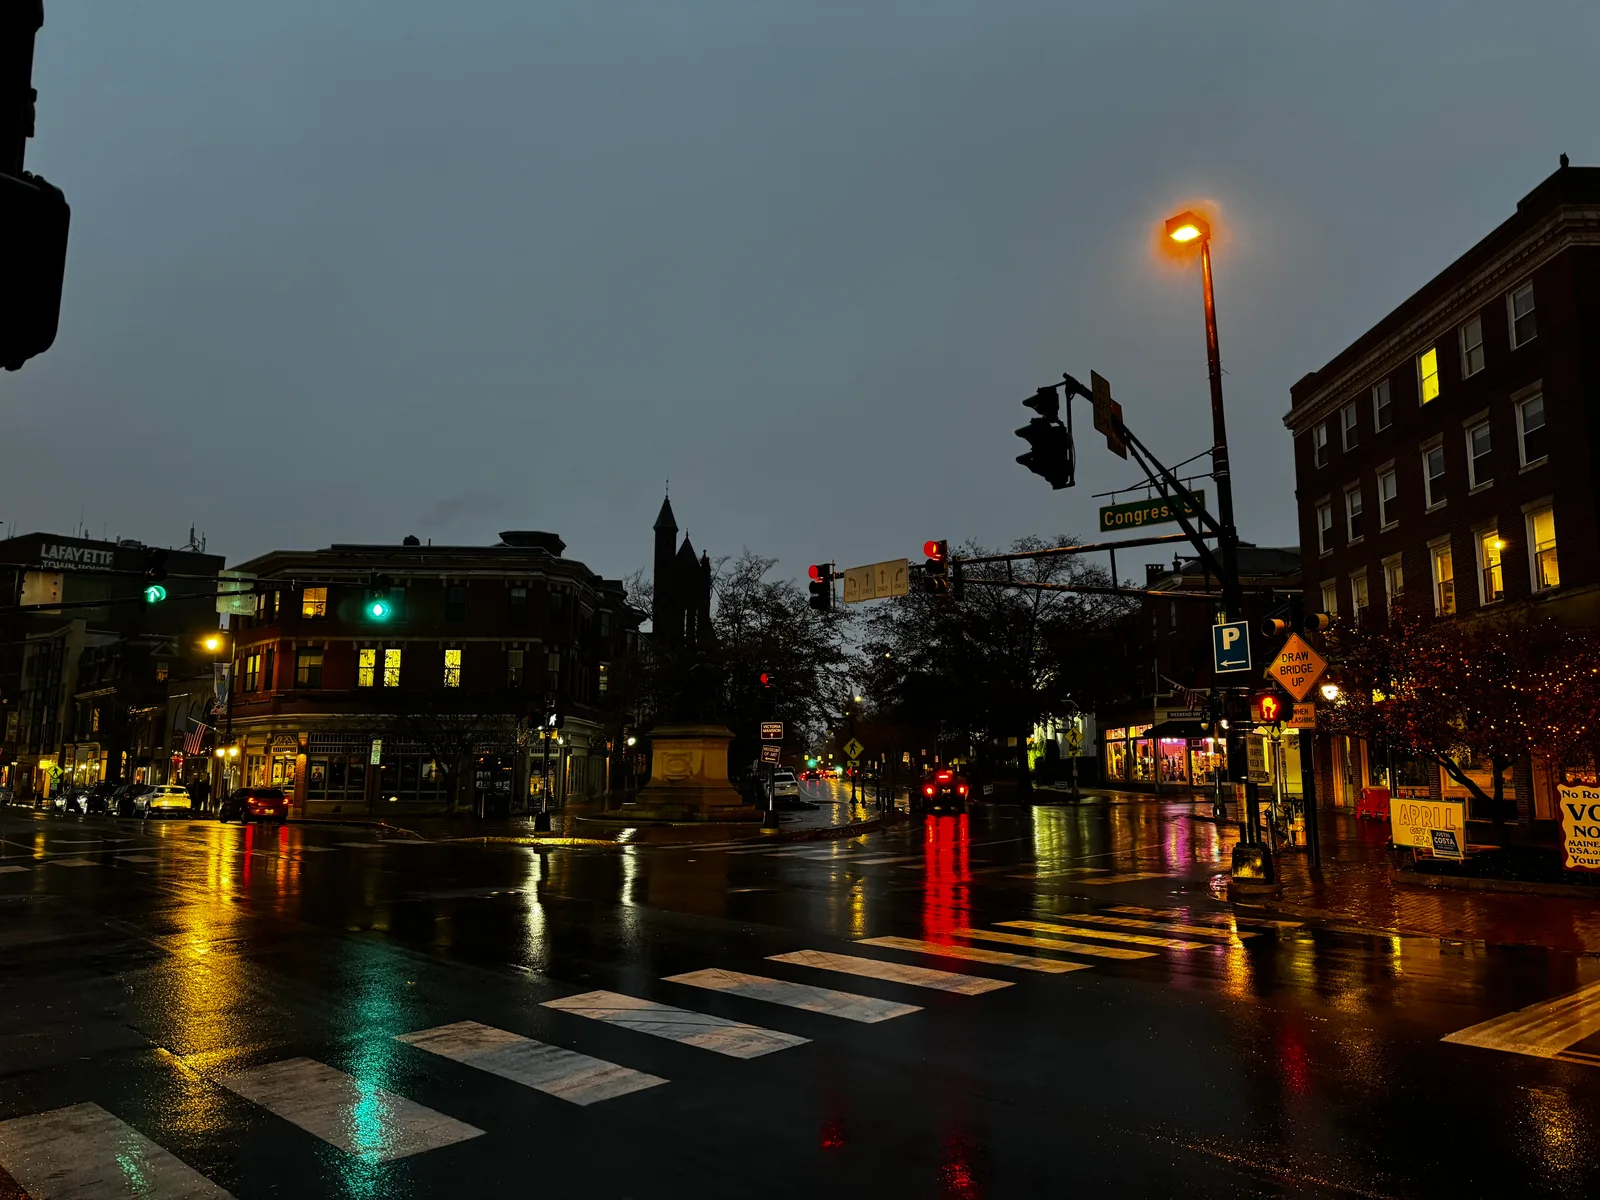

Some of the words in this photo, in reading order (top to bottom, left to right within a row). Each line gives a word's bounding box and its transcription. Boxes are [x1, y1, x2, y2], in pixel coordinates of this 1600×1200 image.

[1104, 504, 1175, 526] Congres
[40, 543, 114, 564] LAFAYETTE
[1222, 627, 1240, 651] P
[1282, 651, 1309, 663] DRAW
[1280, 663, 1313, 675] BRIDGE
[1291, 677, 1305, 687] UP
[1294, 708, 1309, 716] WHEN
[1288, 714, 1315, 724] LASHING
[1562, 790, 1578, 798] No
[1399, 804, 1455, 830] APRIL
[1434, 837, 1455, 845] COSTA
[1571, 855, 1600, 864] Your
